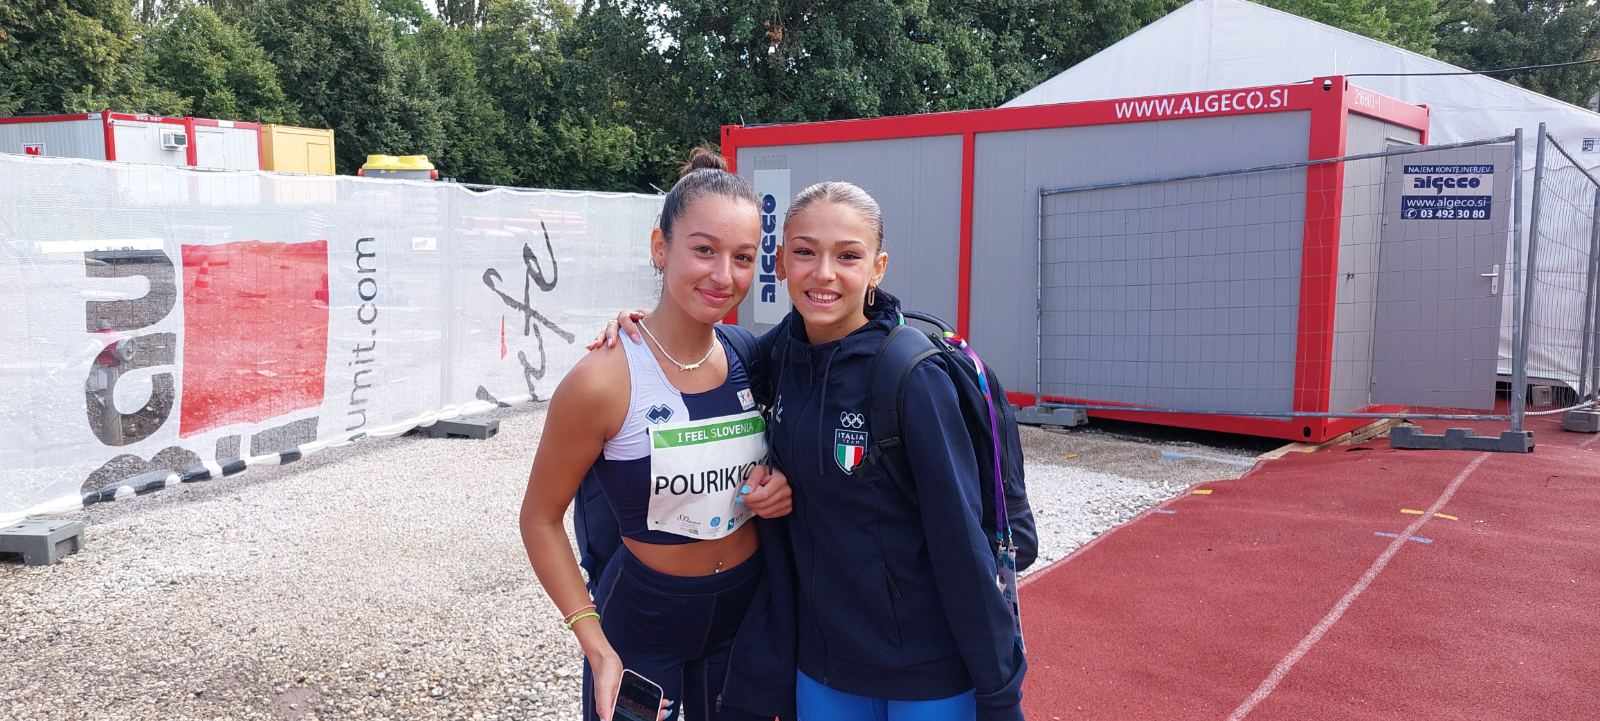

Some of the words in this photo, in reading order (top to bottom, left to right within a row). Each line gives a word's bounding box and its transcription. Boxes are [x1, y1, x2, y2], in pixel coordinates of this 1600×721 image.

[1115, 89, 1288, 119] WWW.ALGECO.SI
[1413, 176, 1480, 195] algeco
[1406, 197, 1486, 209] www.algeco.si
[1420, 209, 1433, 218] 03
[1435, 209, 1454, 218] 492
[1457, 209, 1470, 218] 30
[1472, 209, 1485, 218] 80
[760, 194, 776, 303] algeco
[677, 432, 683, 443] I
[685, 430, 709, 443] FEEL
[710, 423, 754, 439] SLOVENIA
[838, 431, 864, 441] ITALIA
